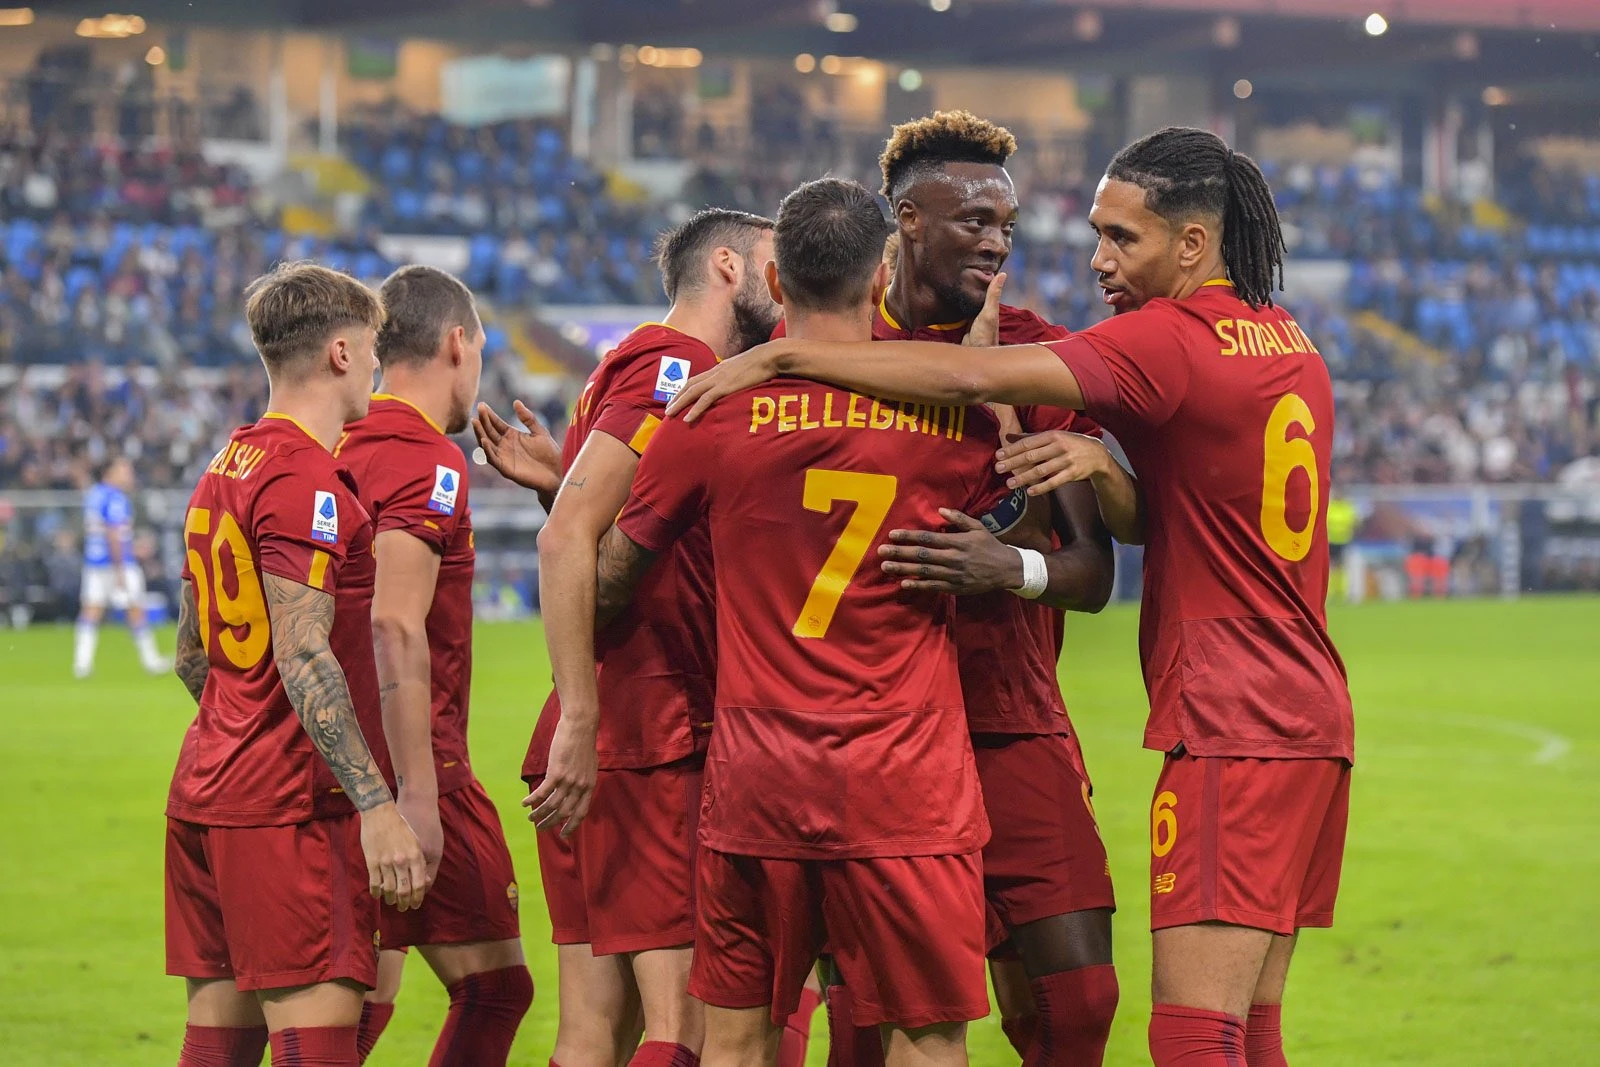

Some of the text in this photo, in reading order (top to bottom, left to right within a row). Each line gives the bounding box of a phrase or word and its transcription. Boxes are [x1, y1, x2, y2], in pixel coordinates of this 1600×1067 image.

[1215, 318, 1319, 357] SMALLIN
[749, 391, 967, 442] PELLEGRINI
[1260, 393, 1319, 562] 6
[323, 532, 335, 541] TIM
[440, 503, 451, 513] TIM
[792, 468, 897, 639] 7
[184, 507, 270, 669] 59
[1152, 790, 1178, 857] 6
